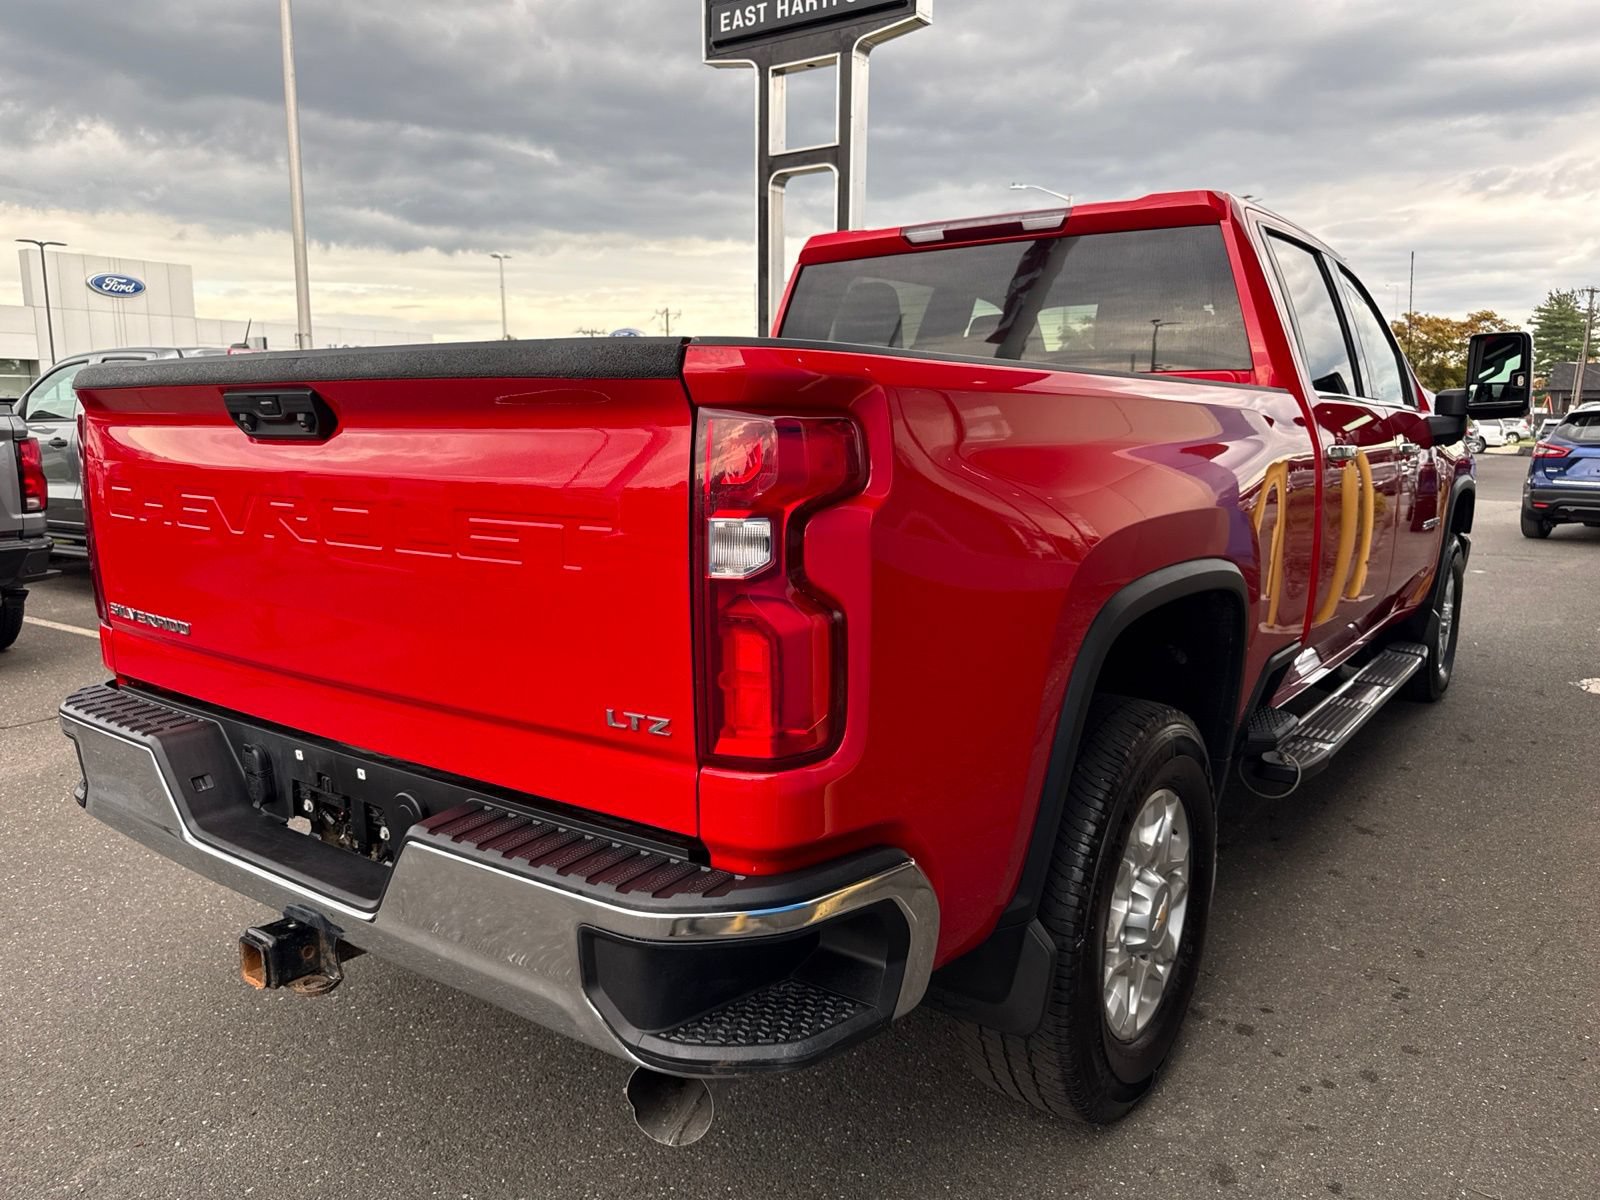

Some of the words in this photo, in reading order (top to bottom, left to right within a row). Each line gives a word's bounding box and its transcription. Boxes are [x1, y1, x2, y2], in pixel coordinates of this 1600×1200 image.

[720, 2, 768, 32] EAST
[102, 277, 136, 293] Ford
[109, 602, 191, 635] SILVERADO
[606, 708, 672, 736] LTZ
